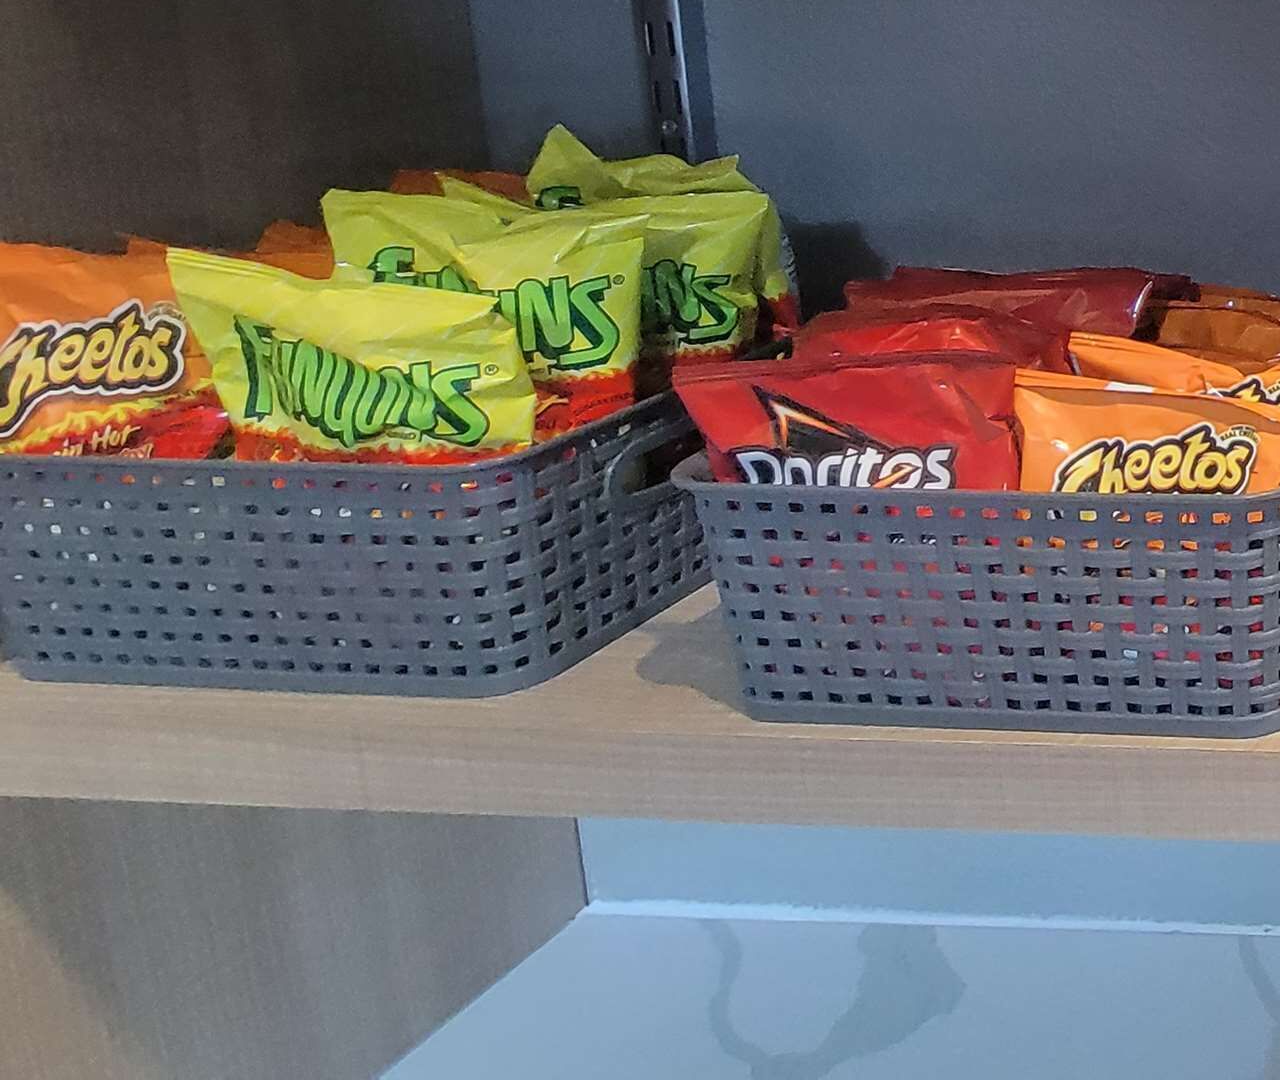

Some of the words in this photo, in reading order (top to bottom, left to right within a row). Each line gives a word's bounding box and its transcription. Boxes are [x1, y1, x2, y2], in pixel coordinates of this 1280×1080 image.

[0, 308, 174, 427] heetos
[735, 447, 953, 490] Doritos
[1058, 425, 1252, 493] Cheetos
